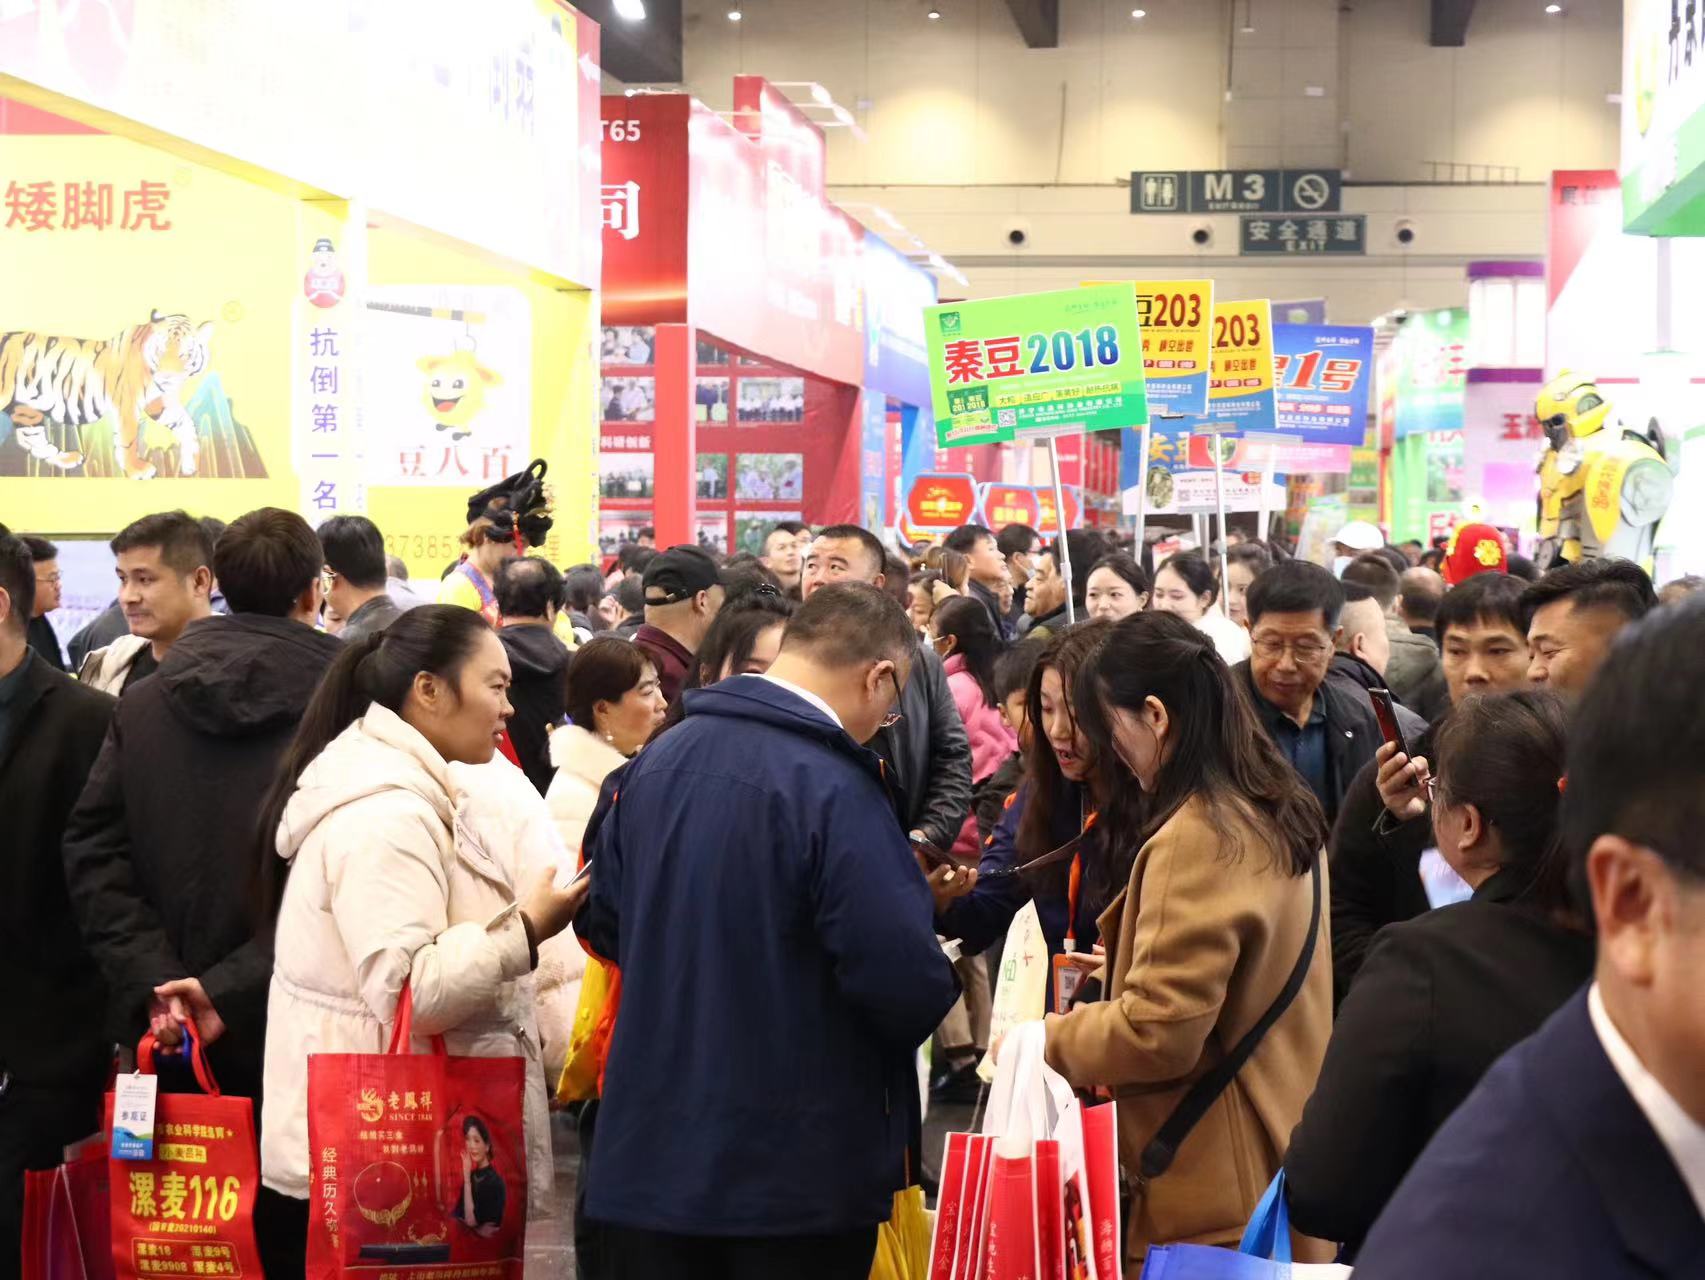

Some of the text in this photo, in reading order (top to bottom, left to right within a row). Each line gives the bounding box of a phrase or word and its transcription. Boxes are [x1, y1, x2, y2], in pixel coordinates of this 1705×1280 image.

[4, 180, 173, 231] 矮脚虎
[1205, 174, 1265, 200] M 3
[1249, 221, 1357, 241] 安全通道
[1286, 241, 1325, 252] EXIT
[944, 325, 1119, 383] 秦豆2018
[309, 327, 338, 510] 抗倒第一名
